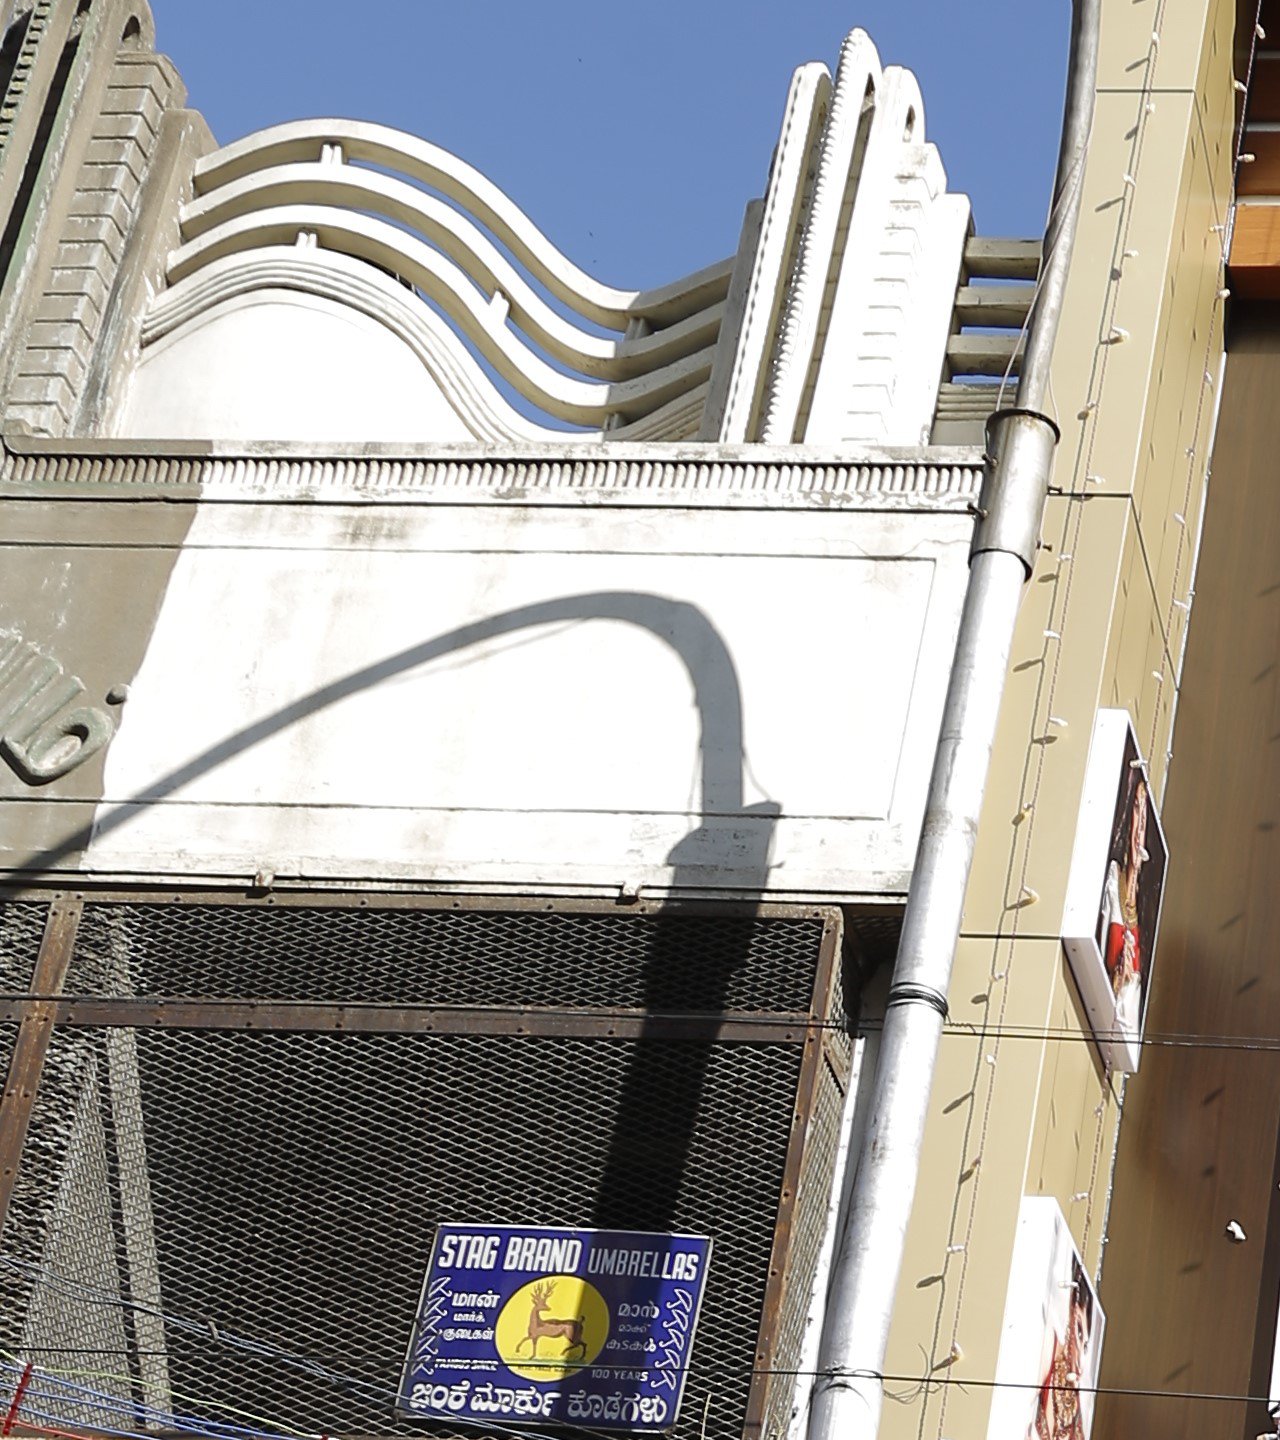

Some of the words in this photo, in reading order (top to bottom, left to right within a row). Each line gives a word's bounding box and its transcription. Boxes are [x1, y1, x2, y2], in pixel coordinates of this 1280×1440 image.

[438, 1234, 500, 1270] STAG
[503, 1236, 583, 1273] BRAND
[587, 1248, 699, 1281] UMBRELLAS
[452, 1289, 500, 1308] மான்
[591, 1369, 610, 1379] 100
[613, 1370, 649, 1382] YEARS
